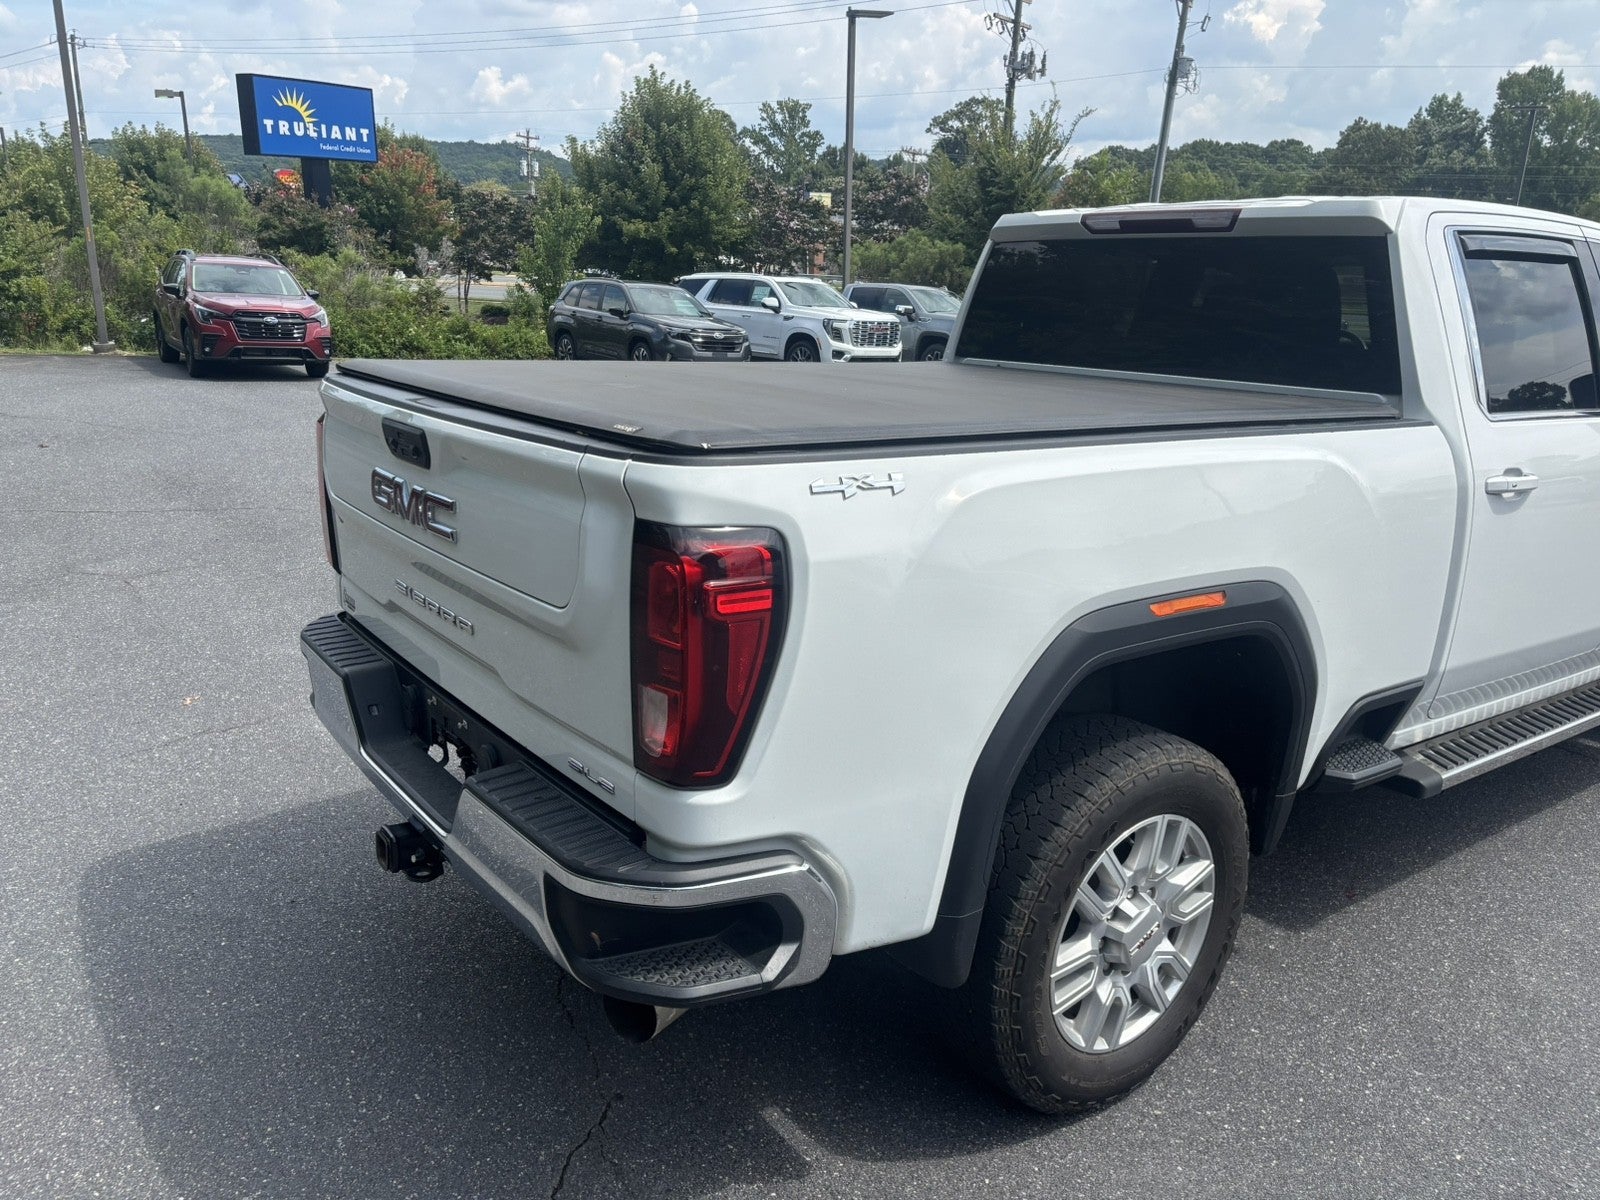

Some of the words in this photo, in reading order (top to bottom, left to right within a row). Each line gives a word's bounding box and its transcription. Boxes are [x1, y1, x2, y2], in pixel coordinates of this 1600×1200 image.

[263, 118, 370, 143] TRULIANT
[320, 143, 339, 151] Federal
[371, 467, 457, 544] GMC
[394, 577, 474, 636] SIERRA
